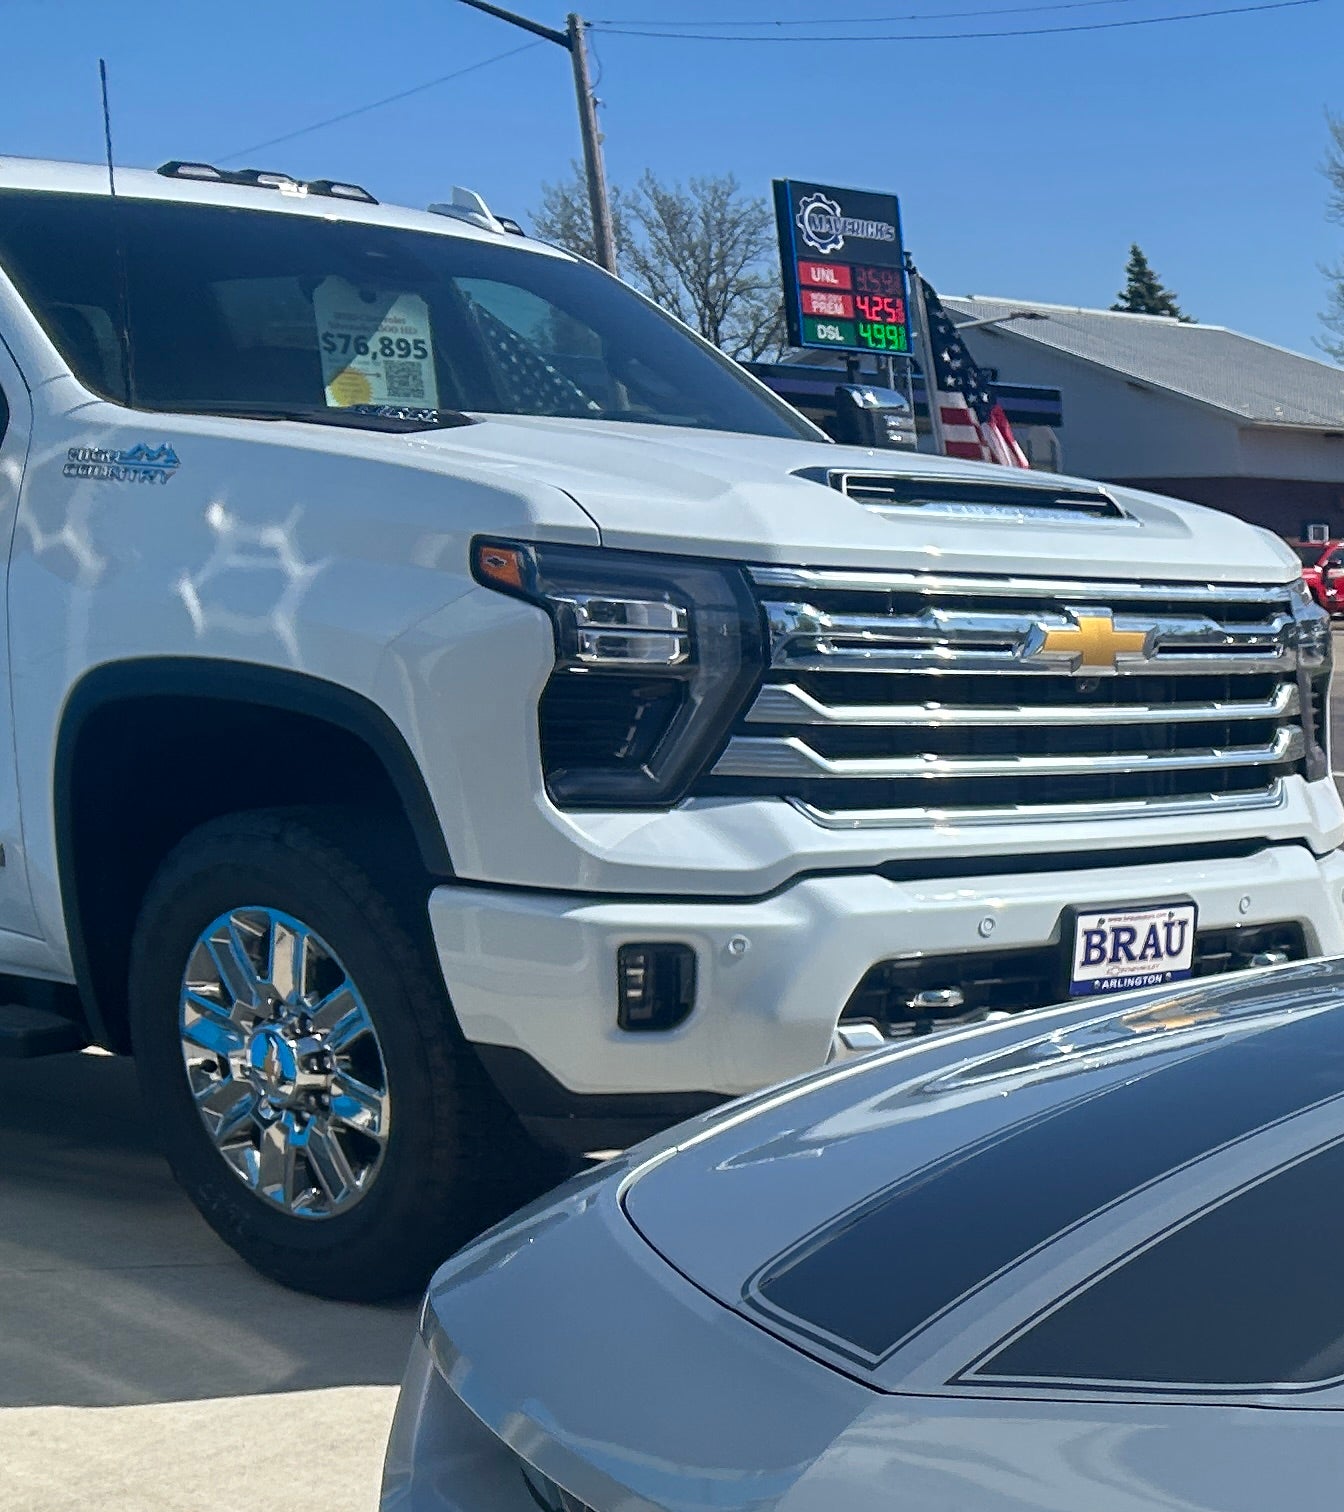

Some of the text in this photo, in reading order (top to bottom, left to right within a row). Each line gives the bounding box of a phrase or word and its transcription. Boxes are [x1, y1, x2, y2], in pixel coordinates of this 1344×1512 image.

[811, 267, 839, 284] UNL
[811, 301, 845, 315] PREM
[817, 324, 844, 341] DSL
[322, 331, 428, 360] $76,895
[62, 463, 174, 486] COUNTRY
[1080, 920, 1188, 967] BRAU
[1101, 973, 1163, 990] ARLINGTON
